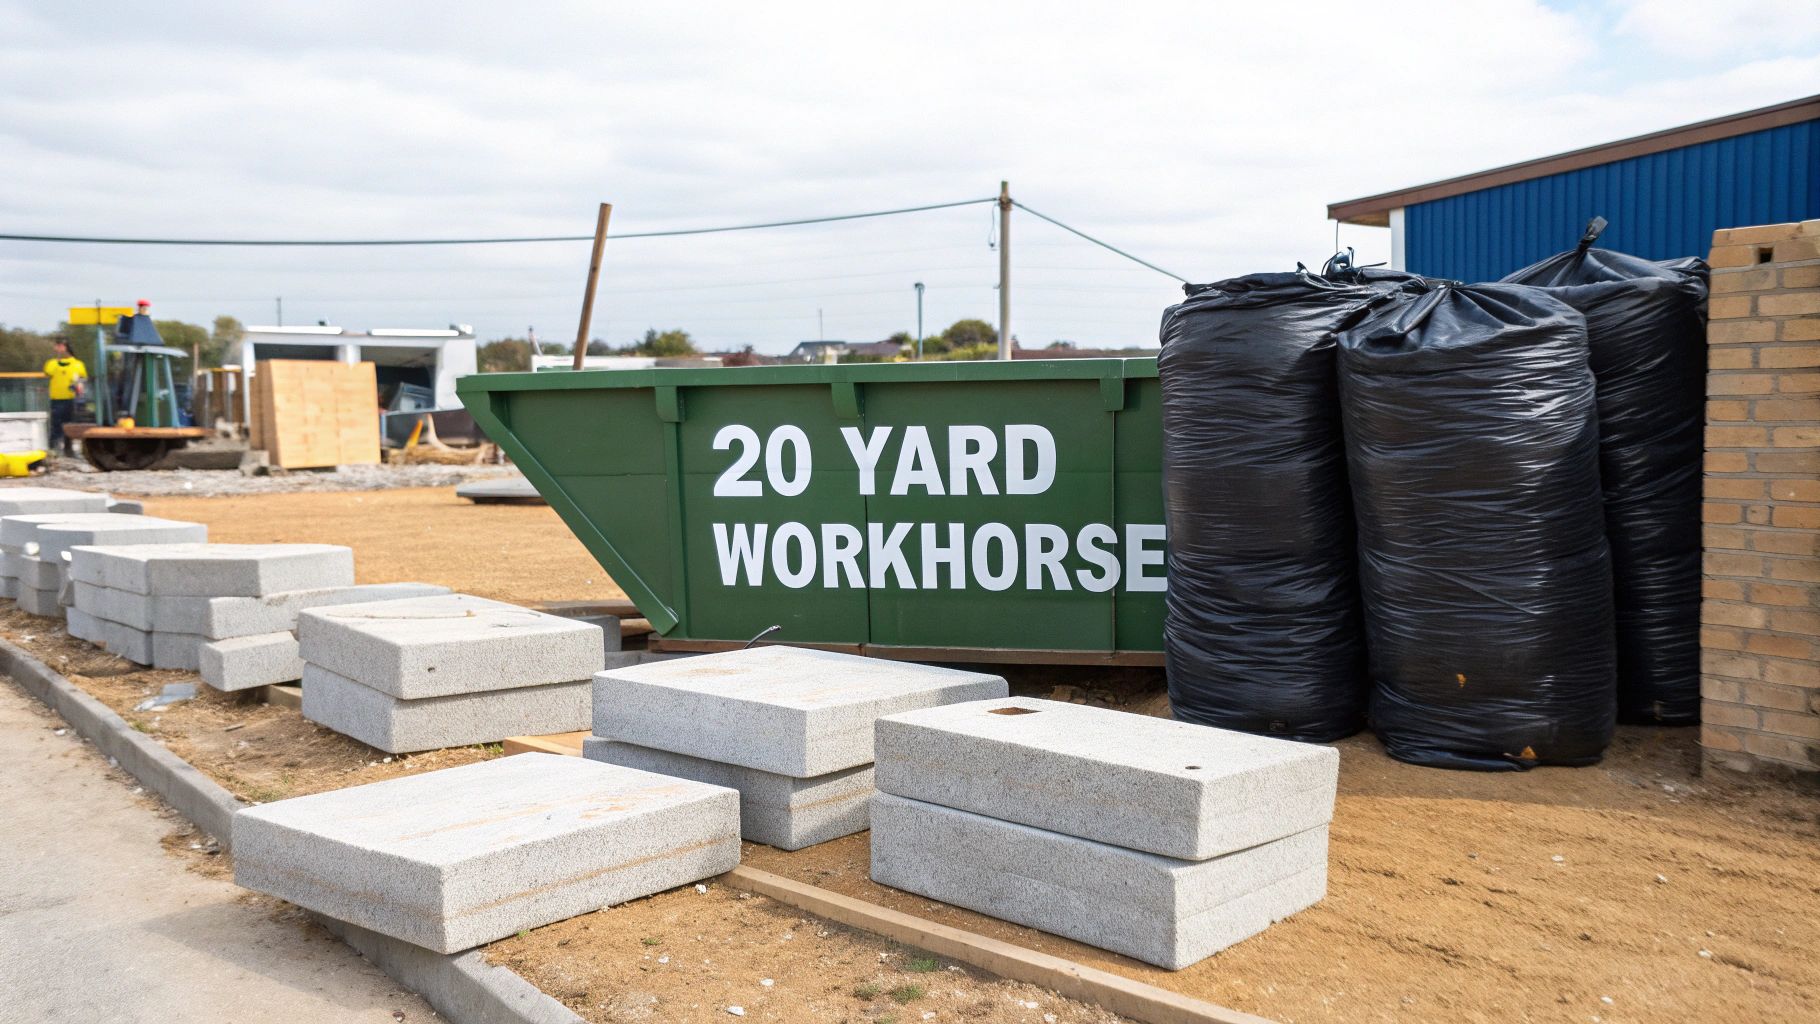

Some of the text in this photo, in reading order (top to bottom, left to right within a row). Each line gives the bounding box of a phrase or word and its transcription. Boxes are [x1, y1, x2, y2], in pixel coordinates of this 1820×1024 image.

[712, 423, 1057, 497] 20 YARD
[712, 521, 1168, 593] WORKHORSE
